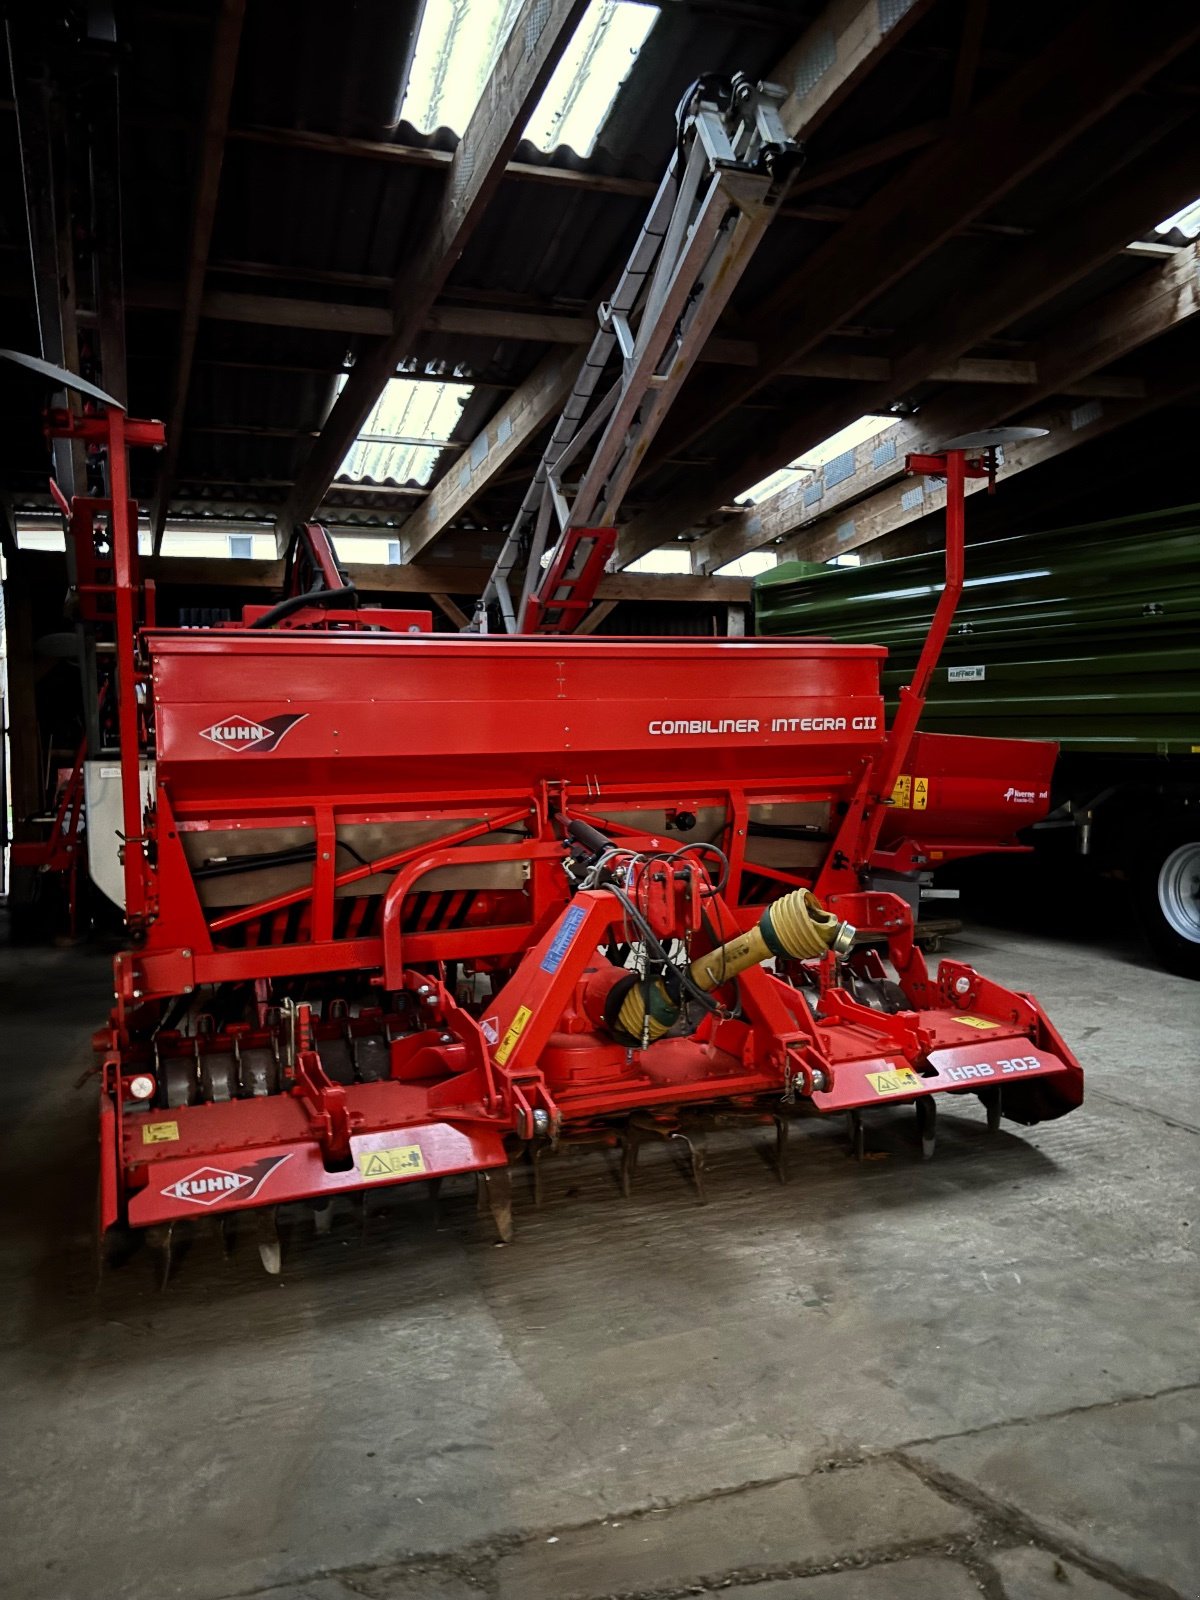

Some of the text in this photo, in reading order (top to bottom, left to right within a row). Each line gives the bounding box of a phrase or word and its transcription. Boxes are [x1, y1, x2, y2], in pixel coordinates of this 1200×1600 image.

[210, 726, 264, 740] KUHN
[648, 716, 878, 735] COMBILINER INTEGRA GII
[947, 1056, 1041, 1080] HRB 303
[174, 1174, 241, 1197] KUHN
